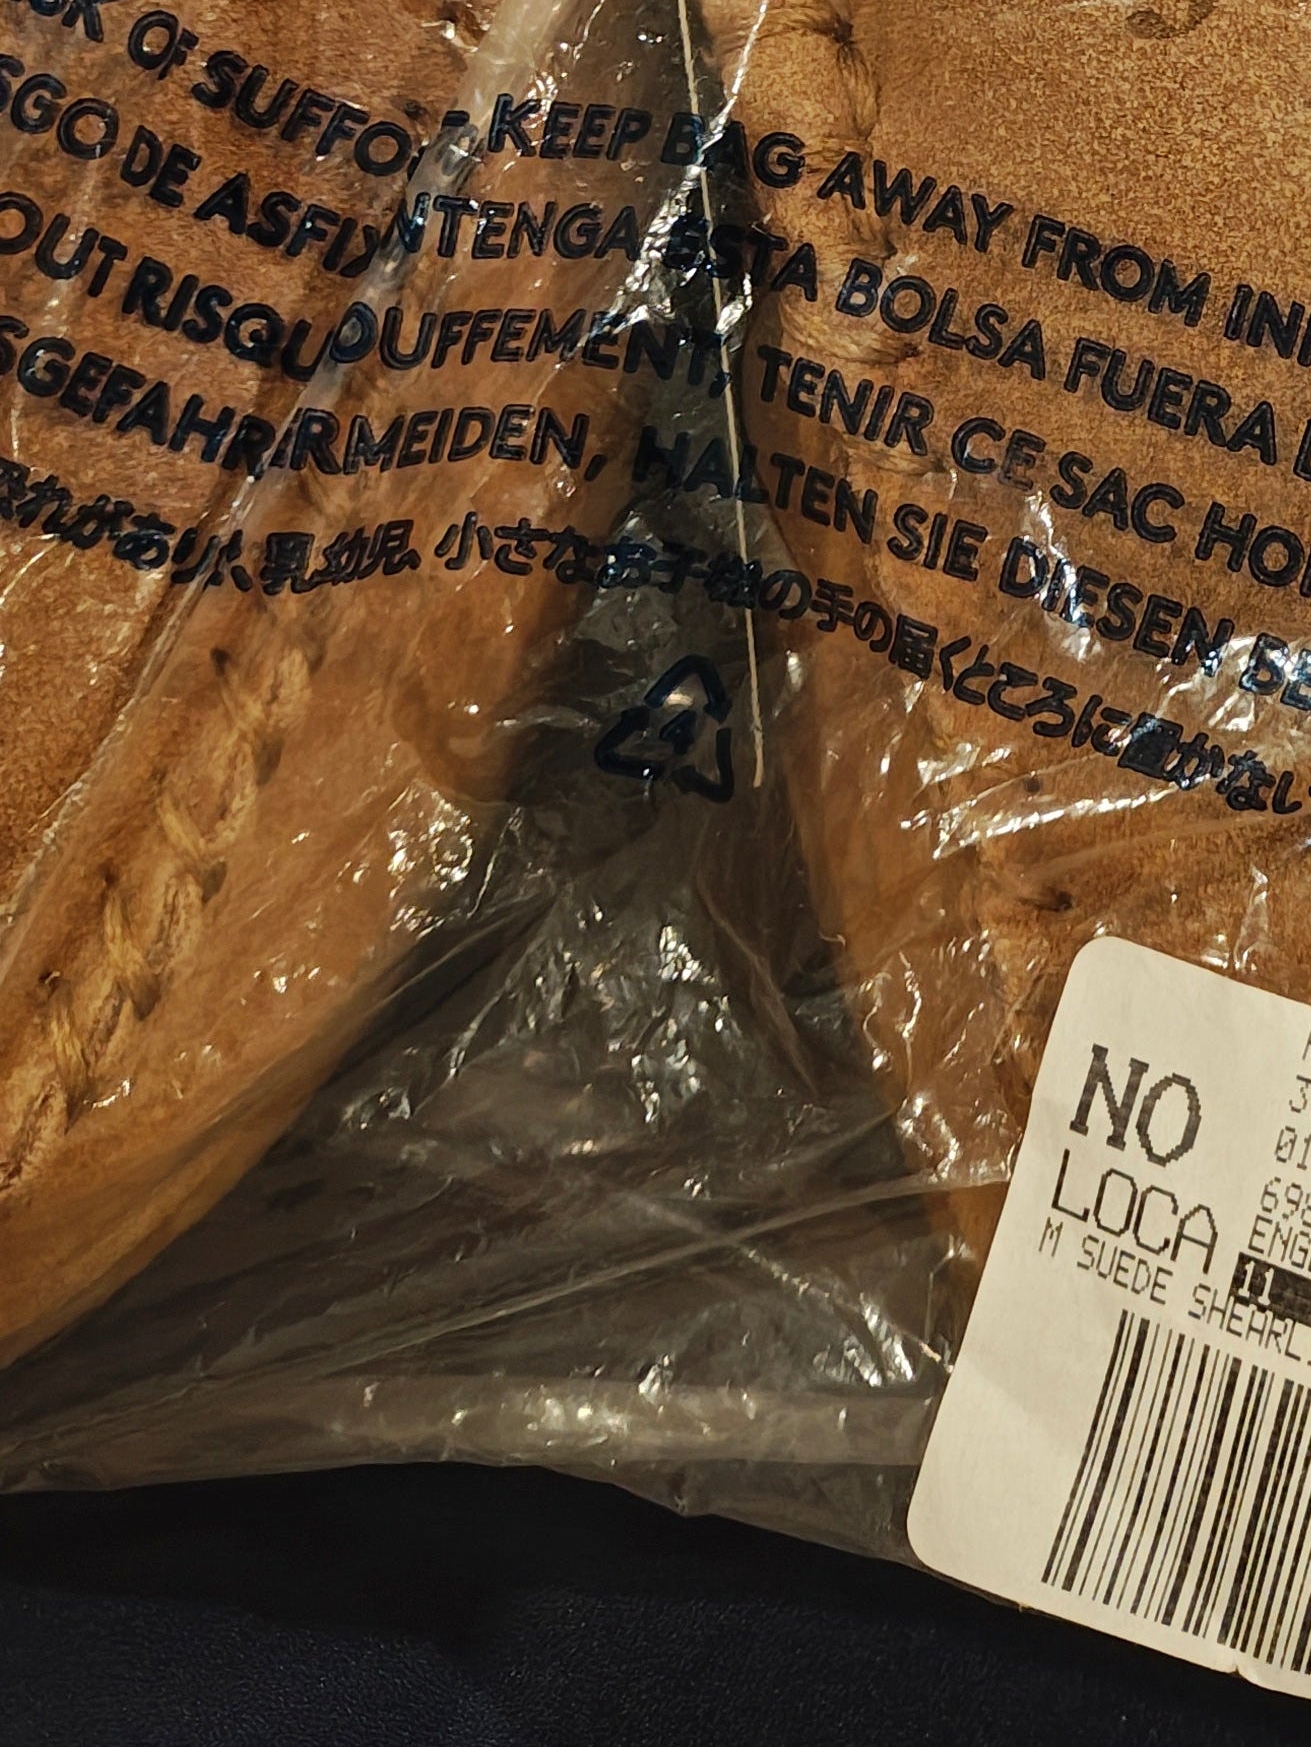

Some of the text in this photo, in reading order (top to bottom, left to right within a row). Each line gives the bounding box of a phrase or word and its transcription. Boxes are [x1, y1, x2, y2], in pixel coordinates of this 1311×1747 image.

[128, 10, 199, 80] OF
[191, 50, 425, 182] SUFFO
[487, 93, 654, 161] KEEP
[660, 112, 807, 189] BAG
[818, 152, 1013, 252] AWAY
[1021, 214, 1210, 328] FROM
[119, 125, 200, 207] DE
[663, 213, 818, 302] ESTA
[836, 258, 1047, 381] BOLSA
[1066, 337, 1278, 465] FUERA
[756, 344, 934, 454] TENIR
[951, 417, 1047, 489] CE
[1049, 451, 1185, 545] SAC
[633, 425, 878, 545] HALTEN
[888, 503, 990, 583] SIE
[999, 539, 1235, 678] DIESEN
[1069, 1043, 1202, 1167] NO
[1037, 1216, 1064, 1258] M
[1076, 1234, 1174, 1305] SUEDE
[1051, 1148, 1219, 1274] LOCA
[1237, 1260, 1274, 1307] 11
